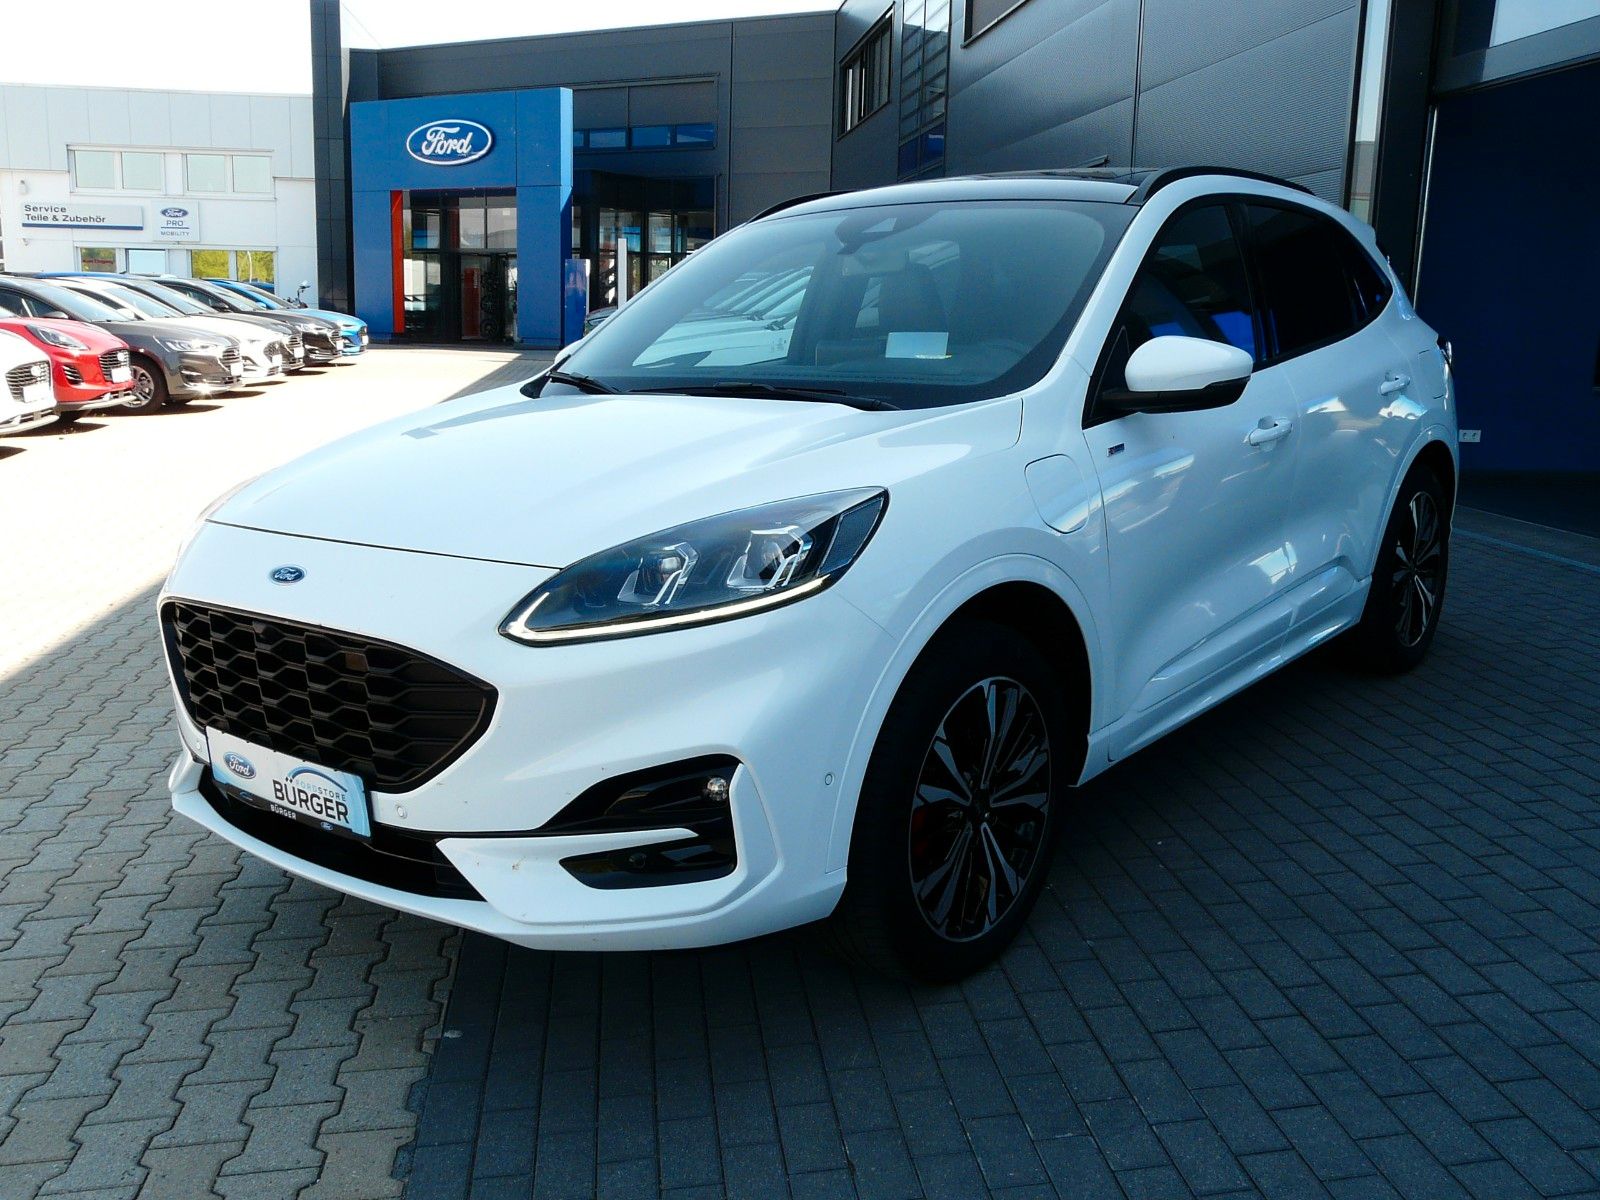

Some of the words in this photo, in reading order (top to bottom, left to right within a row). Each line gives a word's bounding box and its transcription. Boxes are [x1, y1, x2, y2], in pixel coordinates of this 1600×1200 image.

[421, 126, 473, 155] Ford
[24, 204, 67, 213] Service
[25, 213, 49, 222] Teile
[51, 214, 59, 222] &
[62, 214, 106, 223] Zubehör
[229, 754, 251, 776] Ford
[272, 776, 349, 824] BÜRGER
[270, 803, 297, 820] BÜRGER
